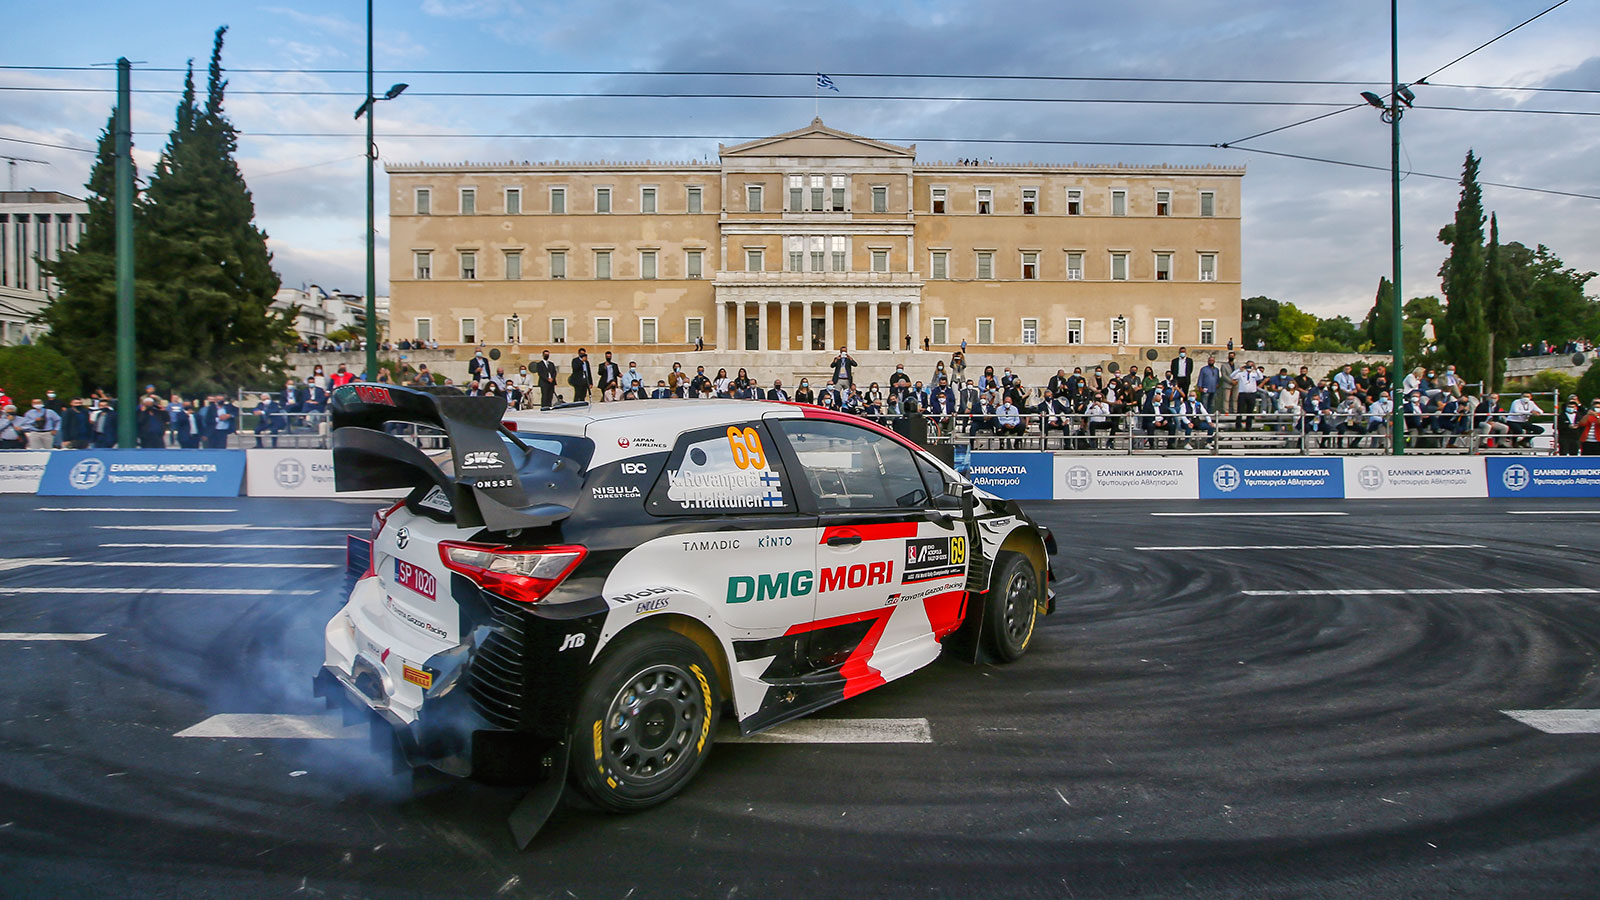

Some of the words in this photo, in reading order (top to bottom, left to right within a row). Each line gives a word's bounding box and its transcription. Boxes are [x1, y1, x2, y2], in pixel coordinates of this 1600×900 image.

[355, 385, 397, 407] MORI
[464, 451, 505, 465] SWS
[727, 426, 766, 470] 69
[970, 466, 1027, 474] ΔΗΜΟΚΡΑΤΙΑ
[592, 486, 640, 494] NISULA
[974, 477, 1020, 486] Αθλητισμού
[682, 540, 740, 551] TAMADIC
[951, 537, 965, 564] 69
[399, 562, 412, 584] SP
[415, 568, 435, 596] 1020
[726, 570, 814, 604] DMG
[819, 560, 894, 593] MORI
[900, 591, 924, 602] TOYOTA
[944, 582, 963, 590] Racing
[426, 623, 447, 639] Racing
[558, 632, 586, 652] JTB
